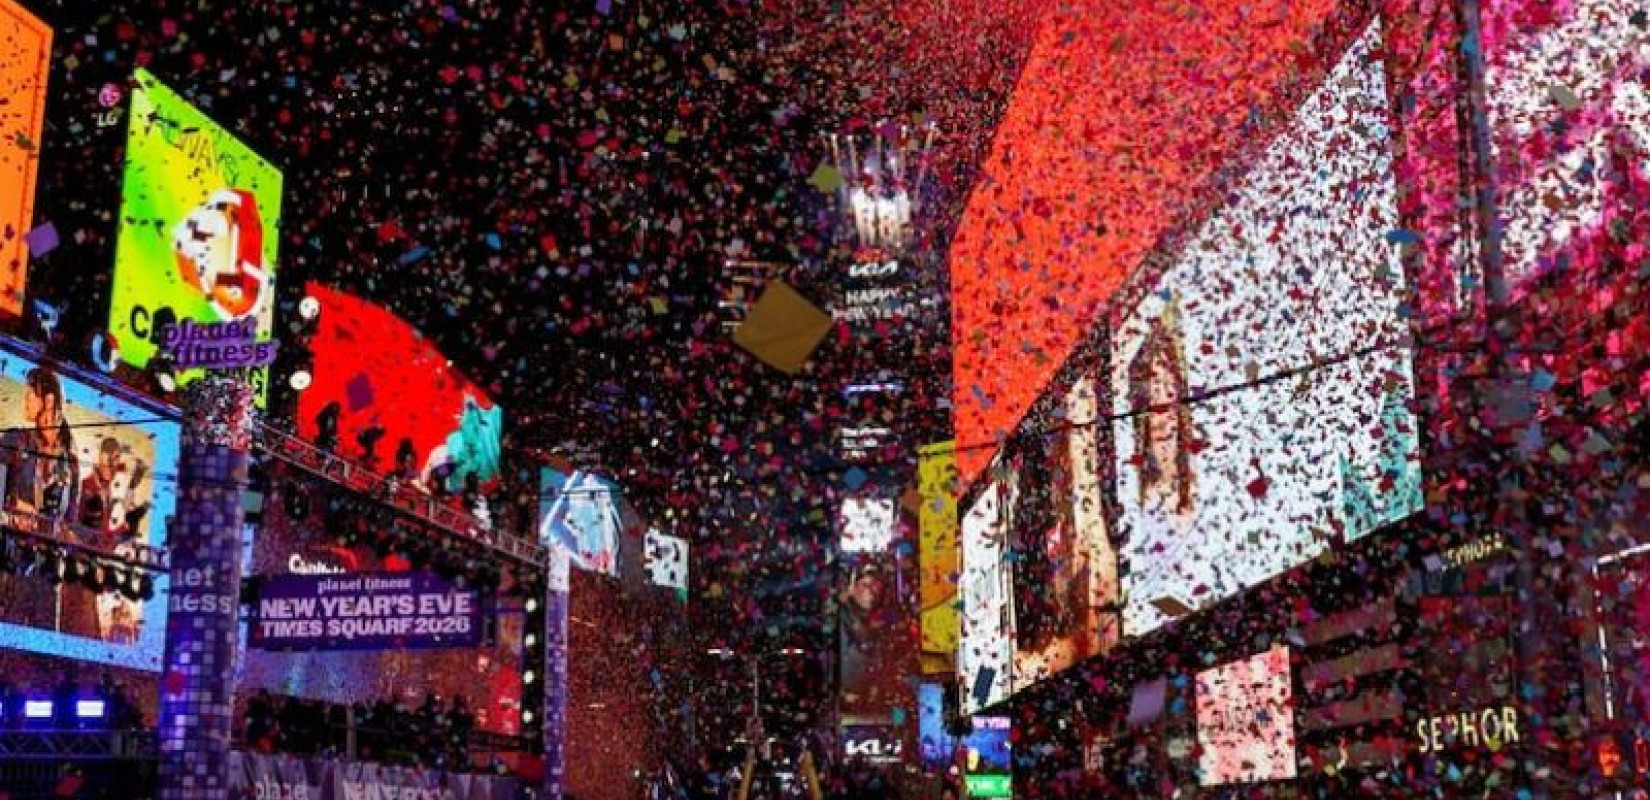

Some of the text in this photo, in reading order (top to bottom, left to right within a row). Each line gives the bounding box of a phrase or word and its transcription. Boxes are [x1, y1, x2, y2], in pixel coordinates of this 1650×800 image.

[98, 111, 119, 127] LG
[162, 315, 257, 346] planet
[173, 341, 272, 368] fitness
[317, 577, 361, 594] planet
[260, 593, 471, 618] NEW YEAR'S EVE
[263, 620, 322, 637] TIMES
[415, 616, 471, 633] 2026
[1417, 706, 1519, 752] SEPHOR
